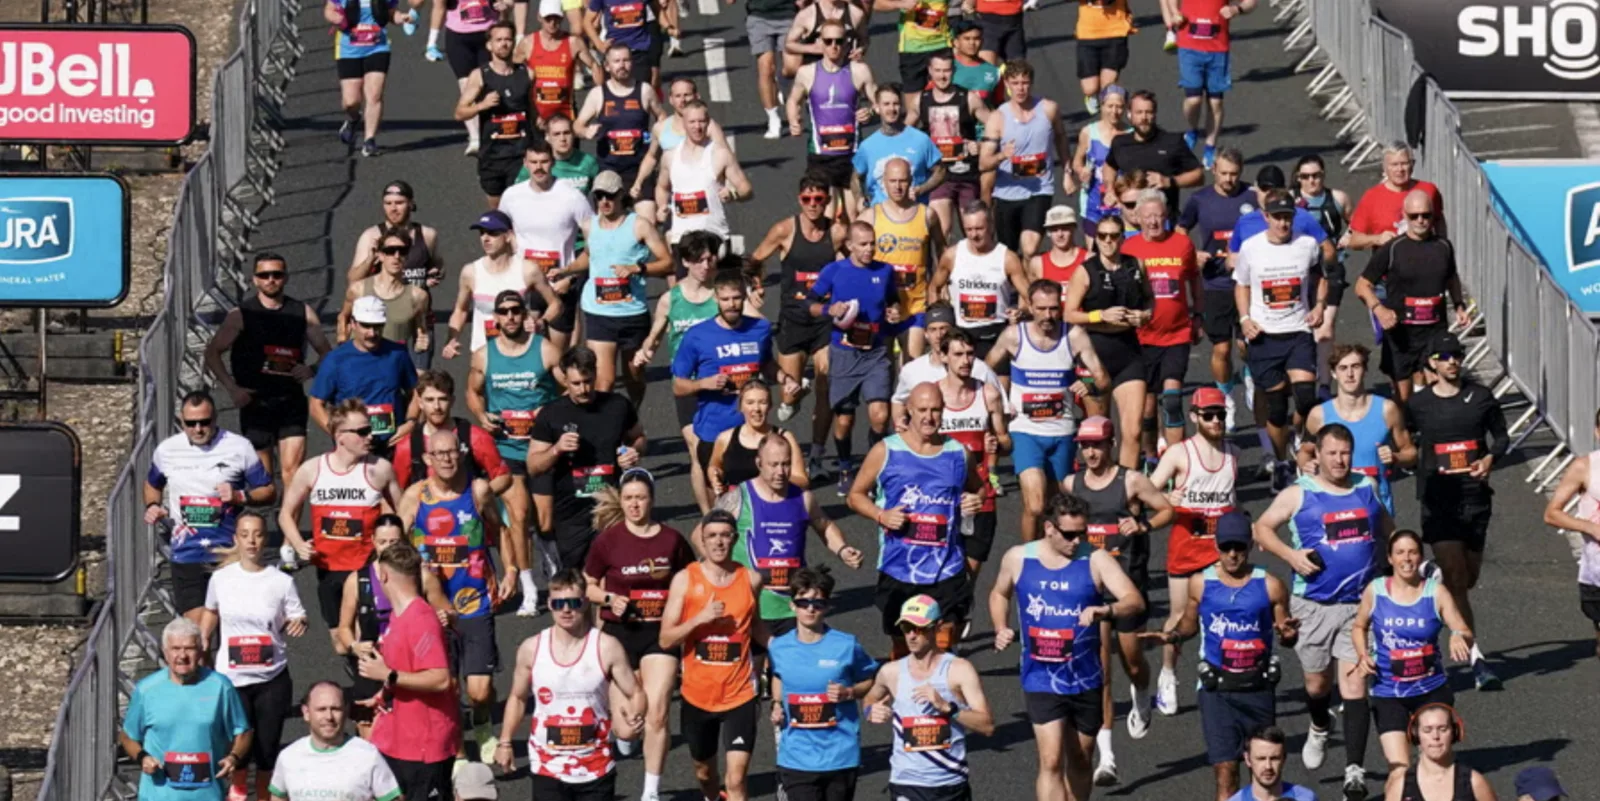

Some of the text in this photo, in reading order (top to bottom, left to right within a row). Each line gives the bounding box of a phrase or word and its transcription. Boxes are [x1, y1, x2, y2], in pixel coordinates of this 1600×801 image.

[59, 103, 155, 128] investing
[959, 279, 997, 290] Striders
[317, 488, 366, 500] ELSWICK
[1188, 491, 1231, 503] ELSWICK
[1040, 581, 1069, 591] TOM
[1383, 617, 1425, 628] HOPE
